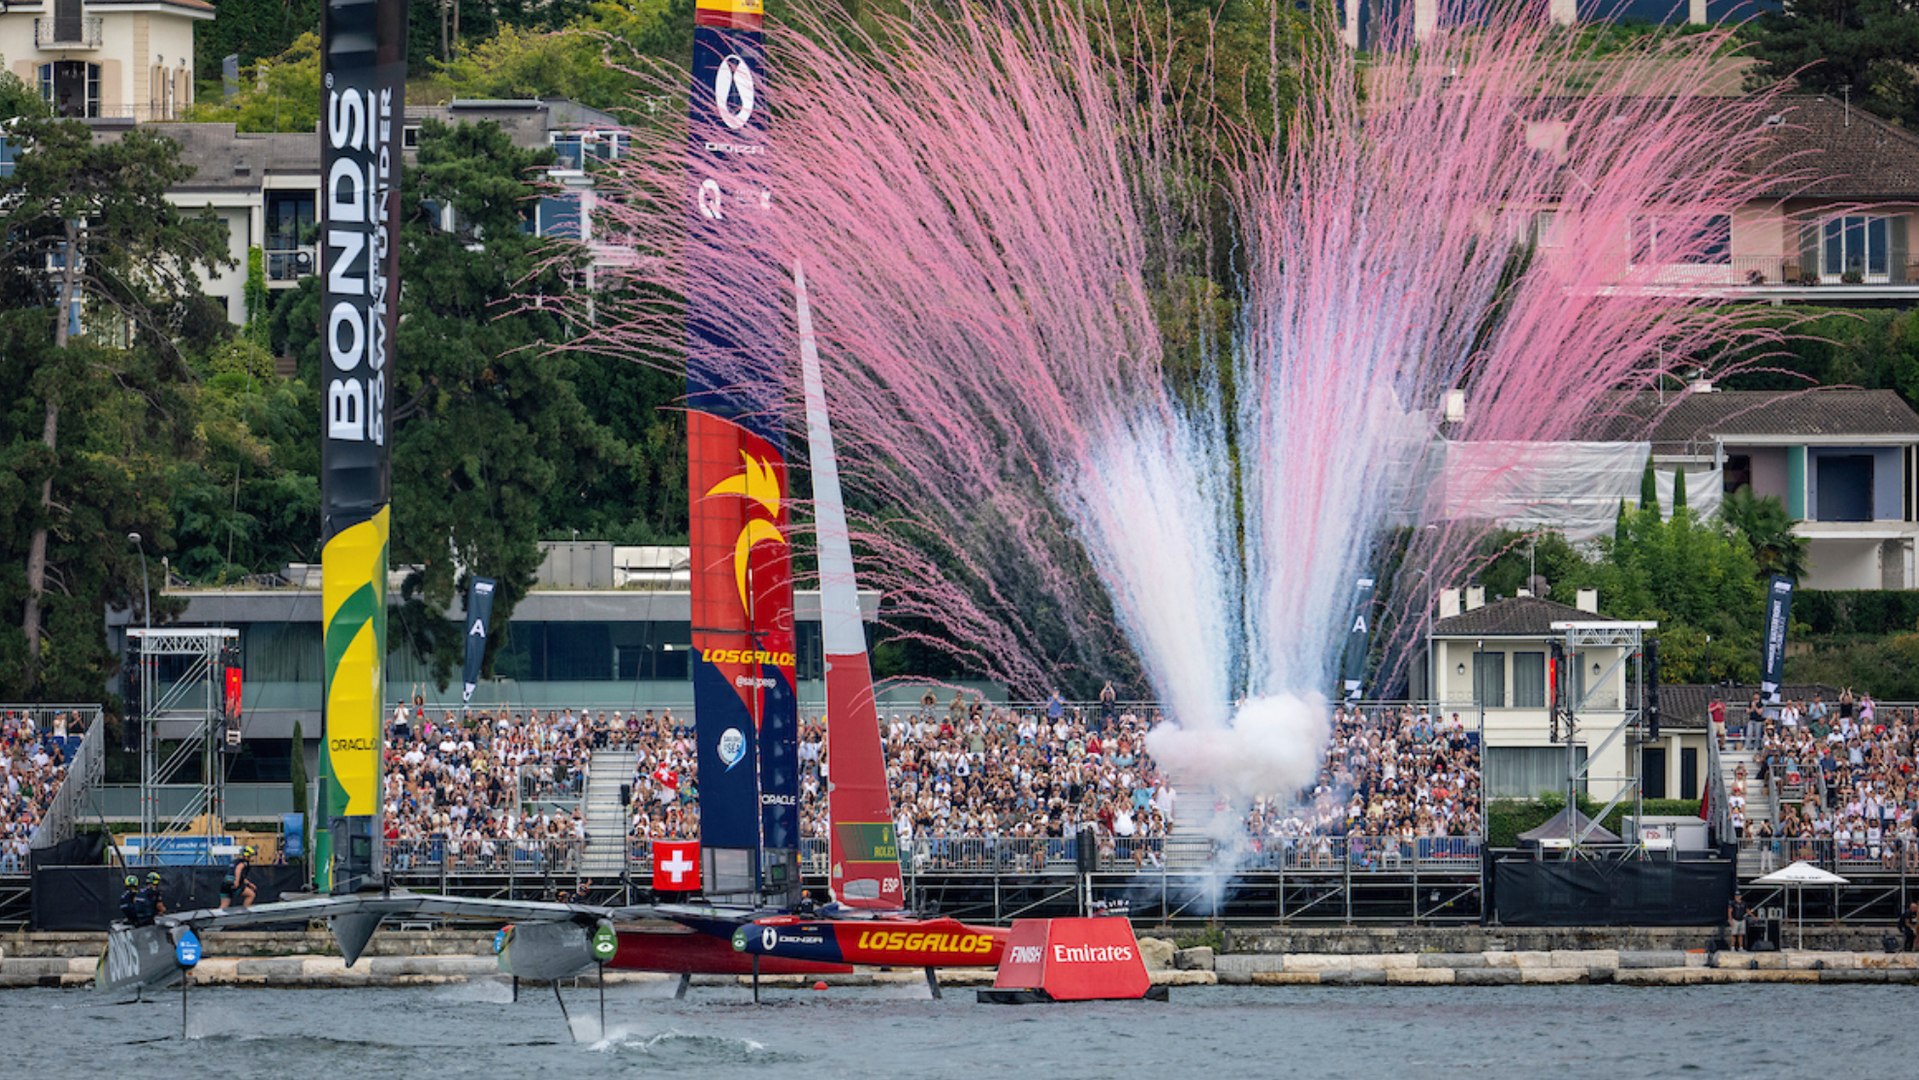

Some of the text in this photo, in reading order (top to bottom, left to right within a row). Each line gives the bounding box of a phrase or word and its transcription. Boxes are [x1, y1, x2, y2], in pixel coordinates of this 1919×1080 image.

[378, 87, 392, 260] UNDER
[329, 88, 365, 441] BONDS
[469, 618, 486, 638] A
[1352, 615, 1367, 633] A
[761, 794, 796, 806] ORACLE
[874, 846, 896, 857] ROLEX
[882, 877, 900, 893] ESP
[858, 930, 994, 954] LOSGALLOS
[1009, 945, 1043, 964] FINISH
[1053, 944, 1133, 963] Emirates
